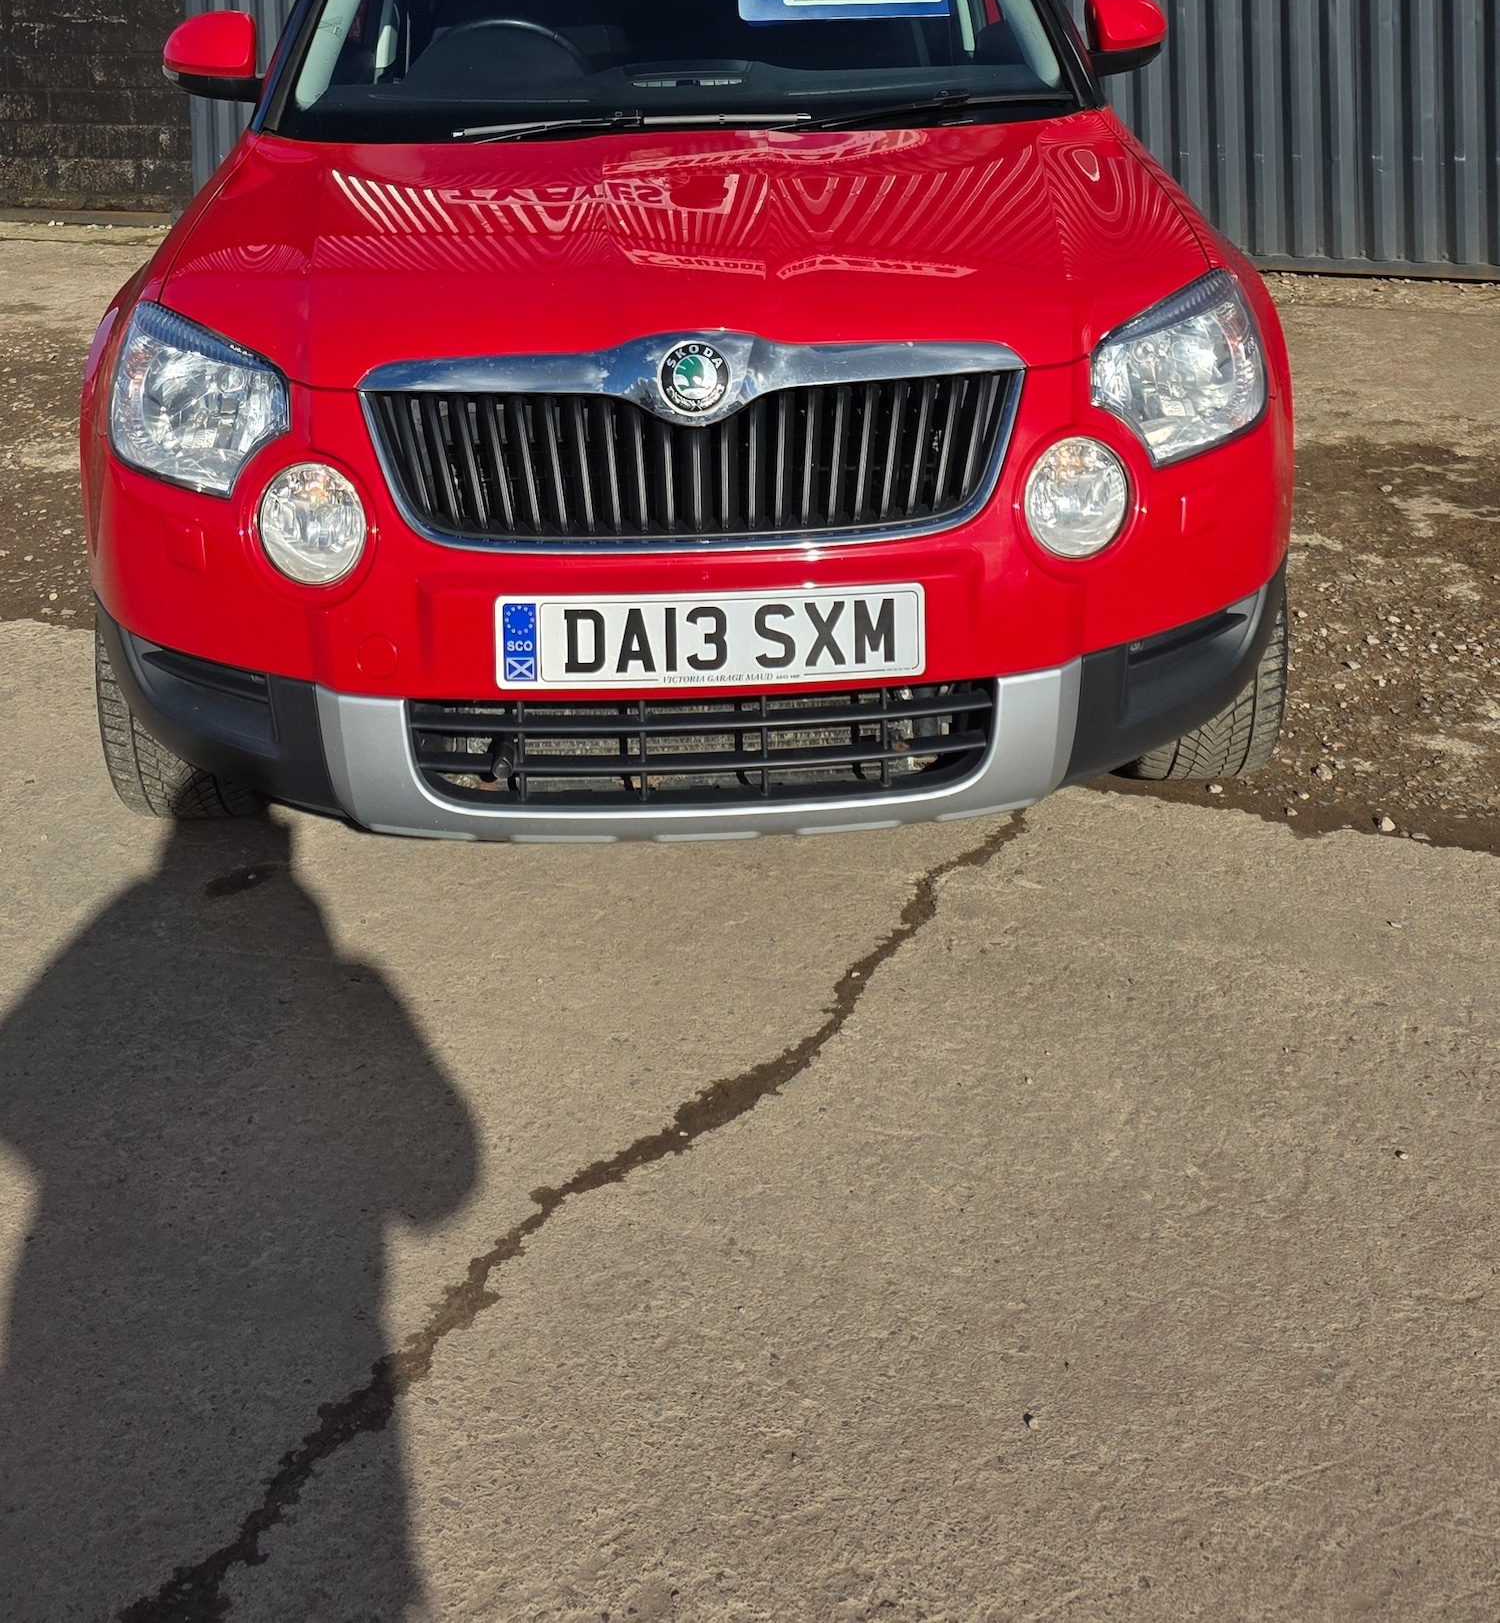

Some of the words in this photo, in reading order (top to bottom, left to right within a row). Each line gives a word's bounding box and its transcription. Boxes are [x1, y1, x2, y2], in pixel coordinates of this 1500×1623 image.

[563, 606, 728, 673] DA13
[754, 598, 895, 668] SXM
[506, 640, 534, 652] SCO
[662, 675, 705, 684] VICTORIA
[707, 674, 744, 682] GARAGE
[745, 672, 773, 681] MAUD
